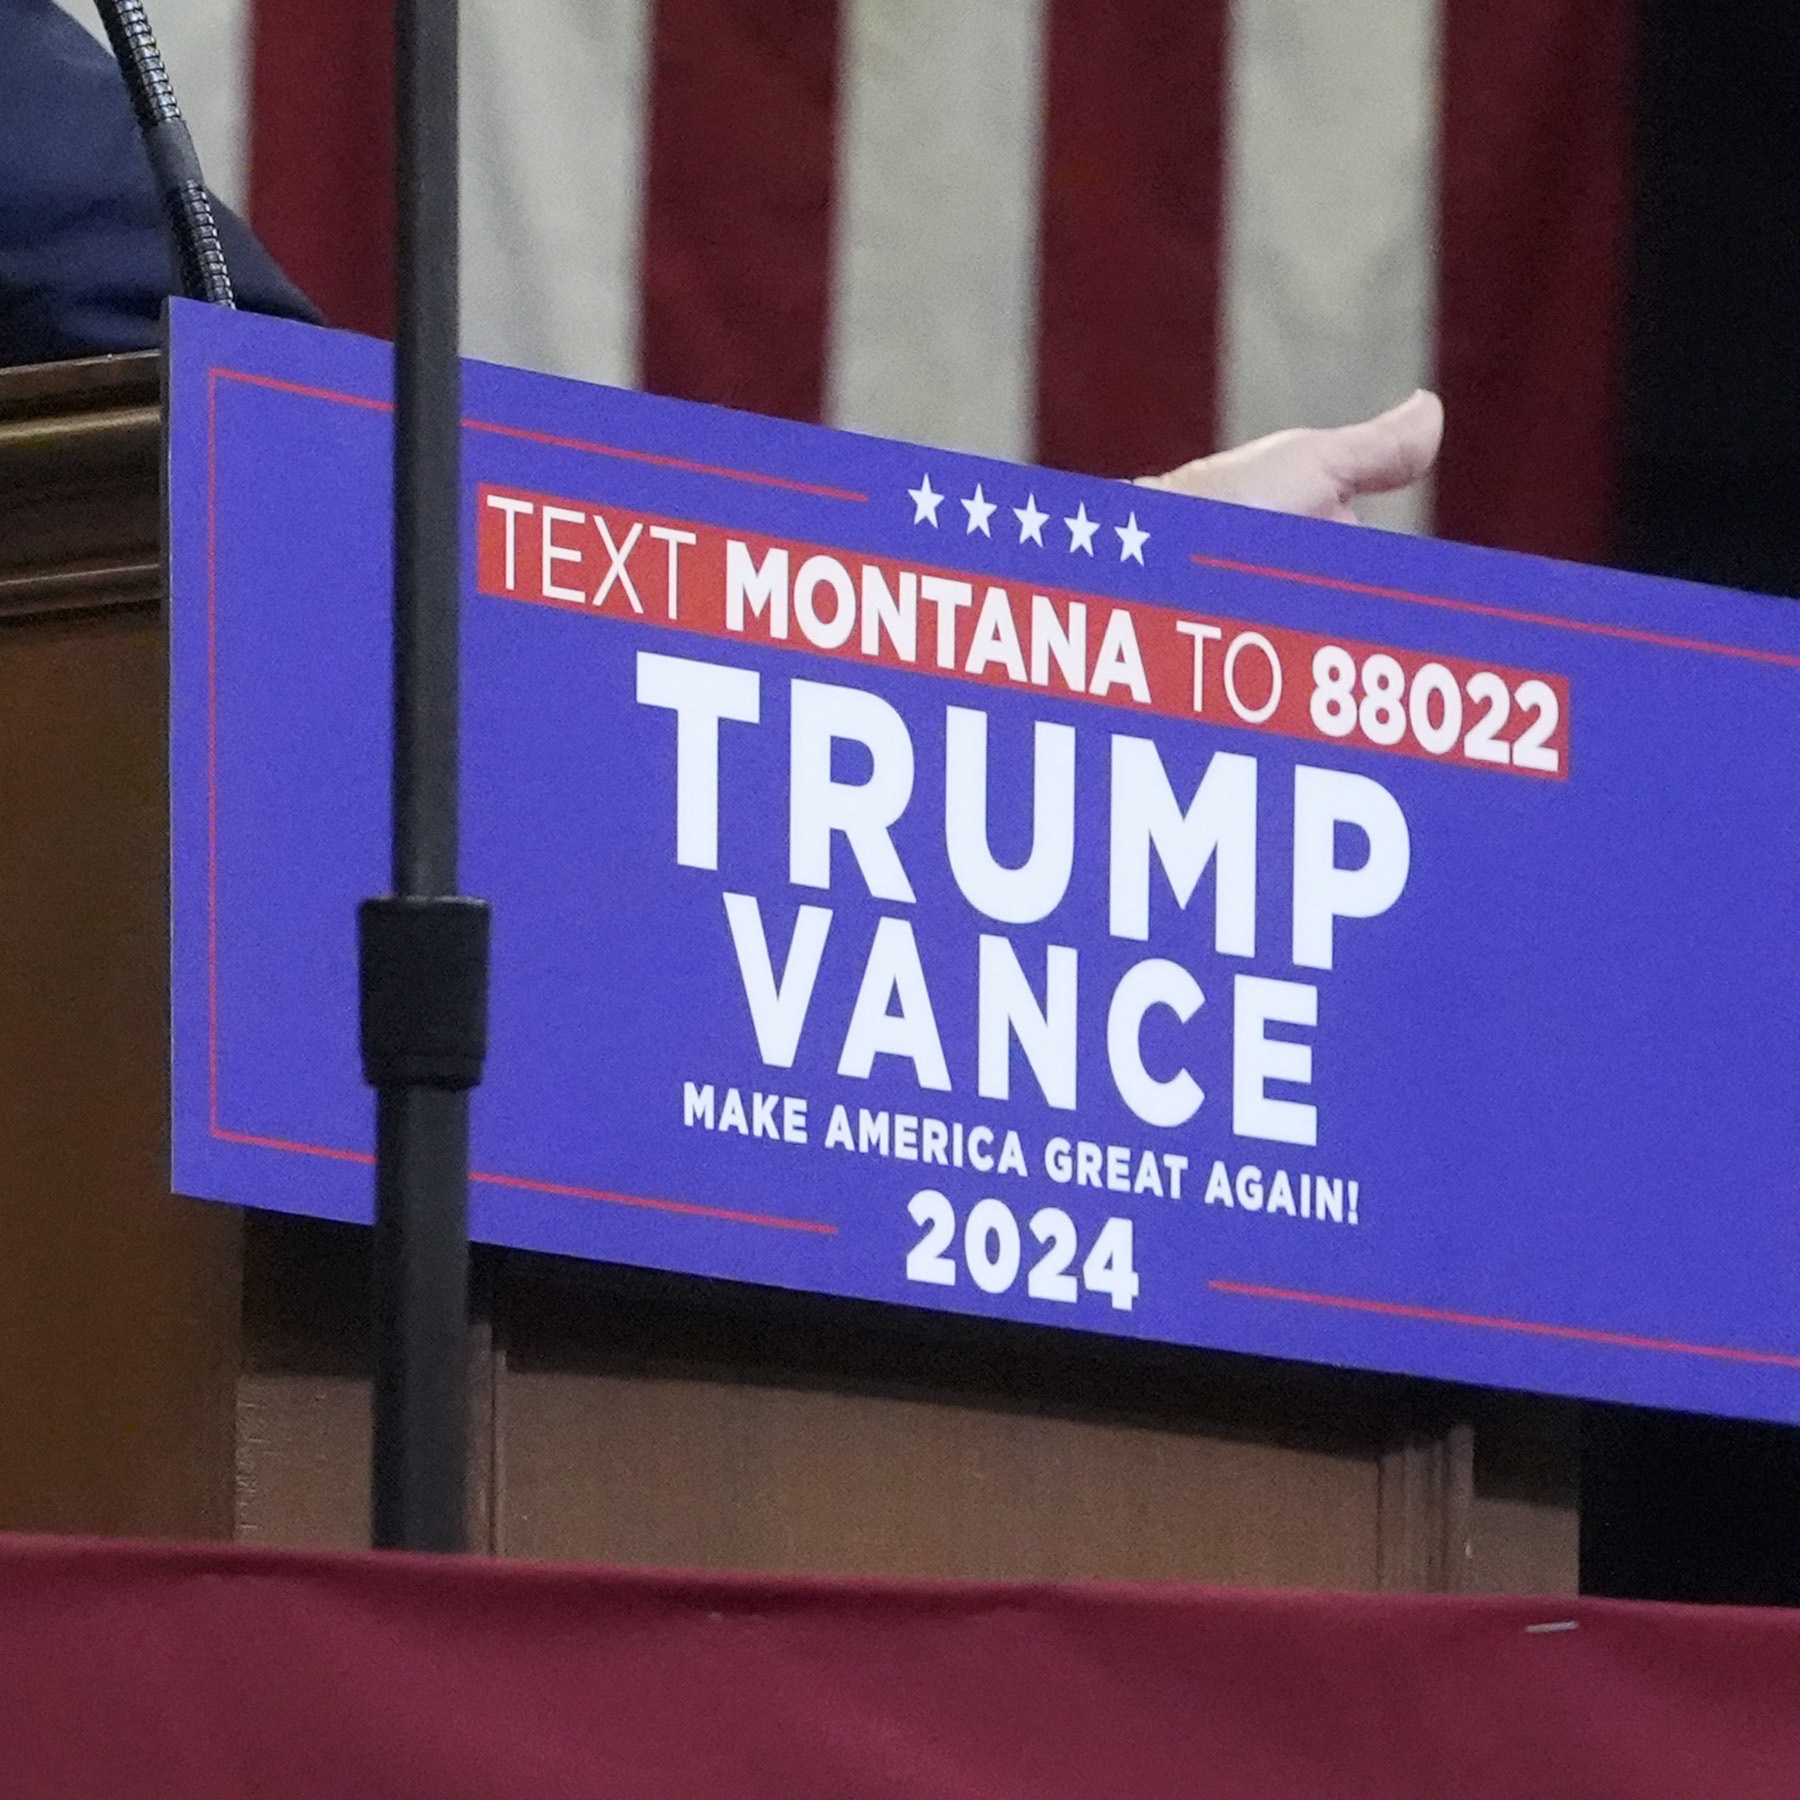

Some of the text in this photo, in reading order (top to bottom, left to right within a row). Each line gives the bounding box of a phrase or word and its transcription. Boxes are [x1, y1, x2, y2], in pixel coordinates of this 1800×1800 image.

[485, 493, 1560, 773] TEXT MONTANA TO 88022
[636, 650, 1410, 970] TRUMP
[722, 890, 1318, 1146] VANCE
[682, 1081, 1360, 1226] MAKE AMERICA GREAT AGAIN!
[906, 1189, 1140, 1312] 2024
